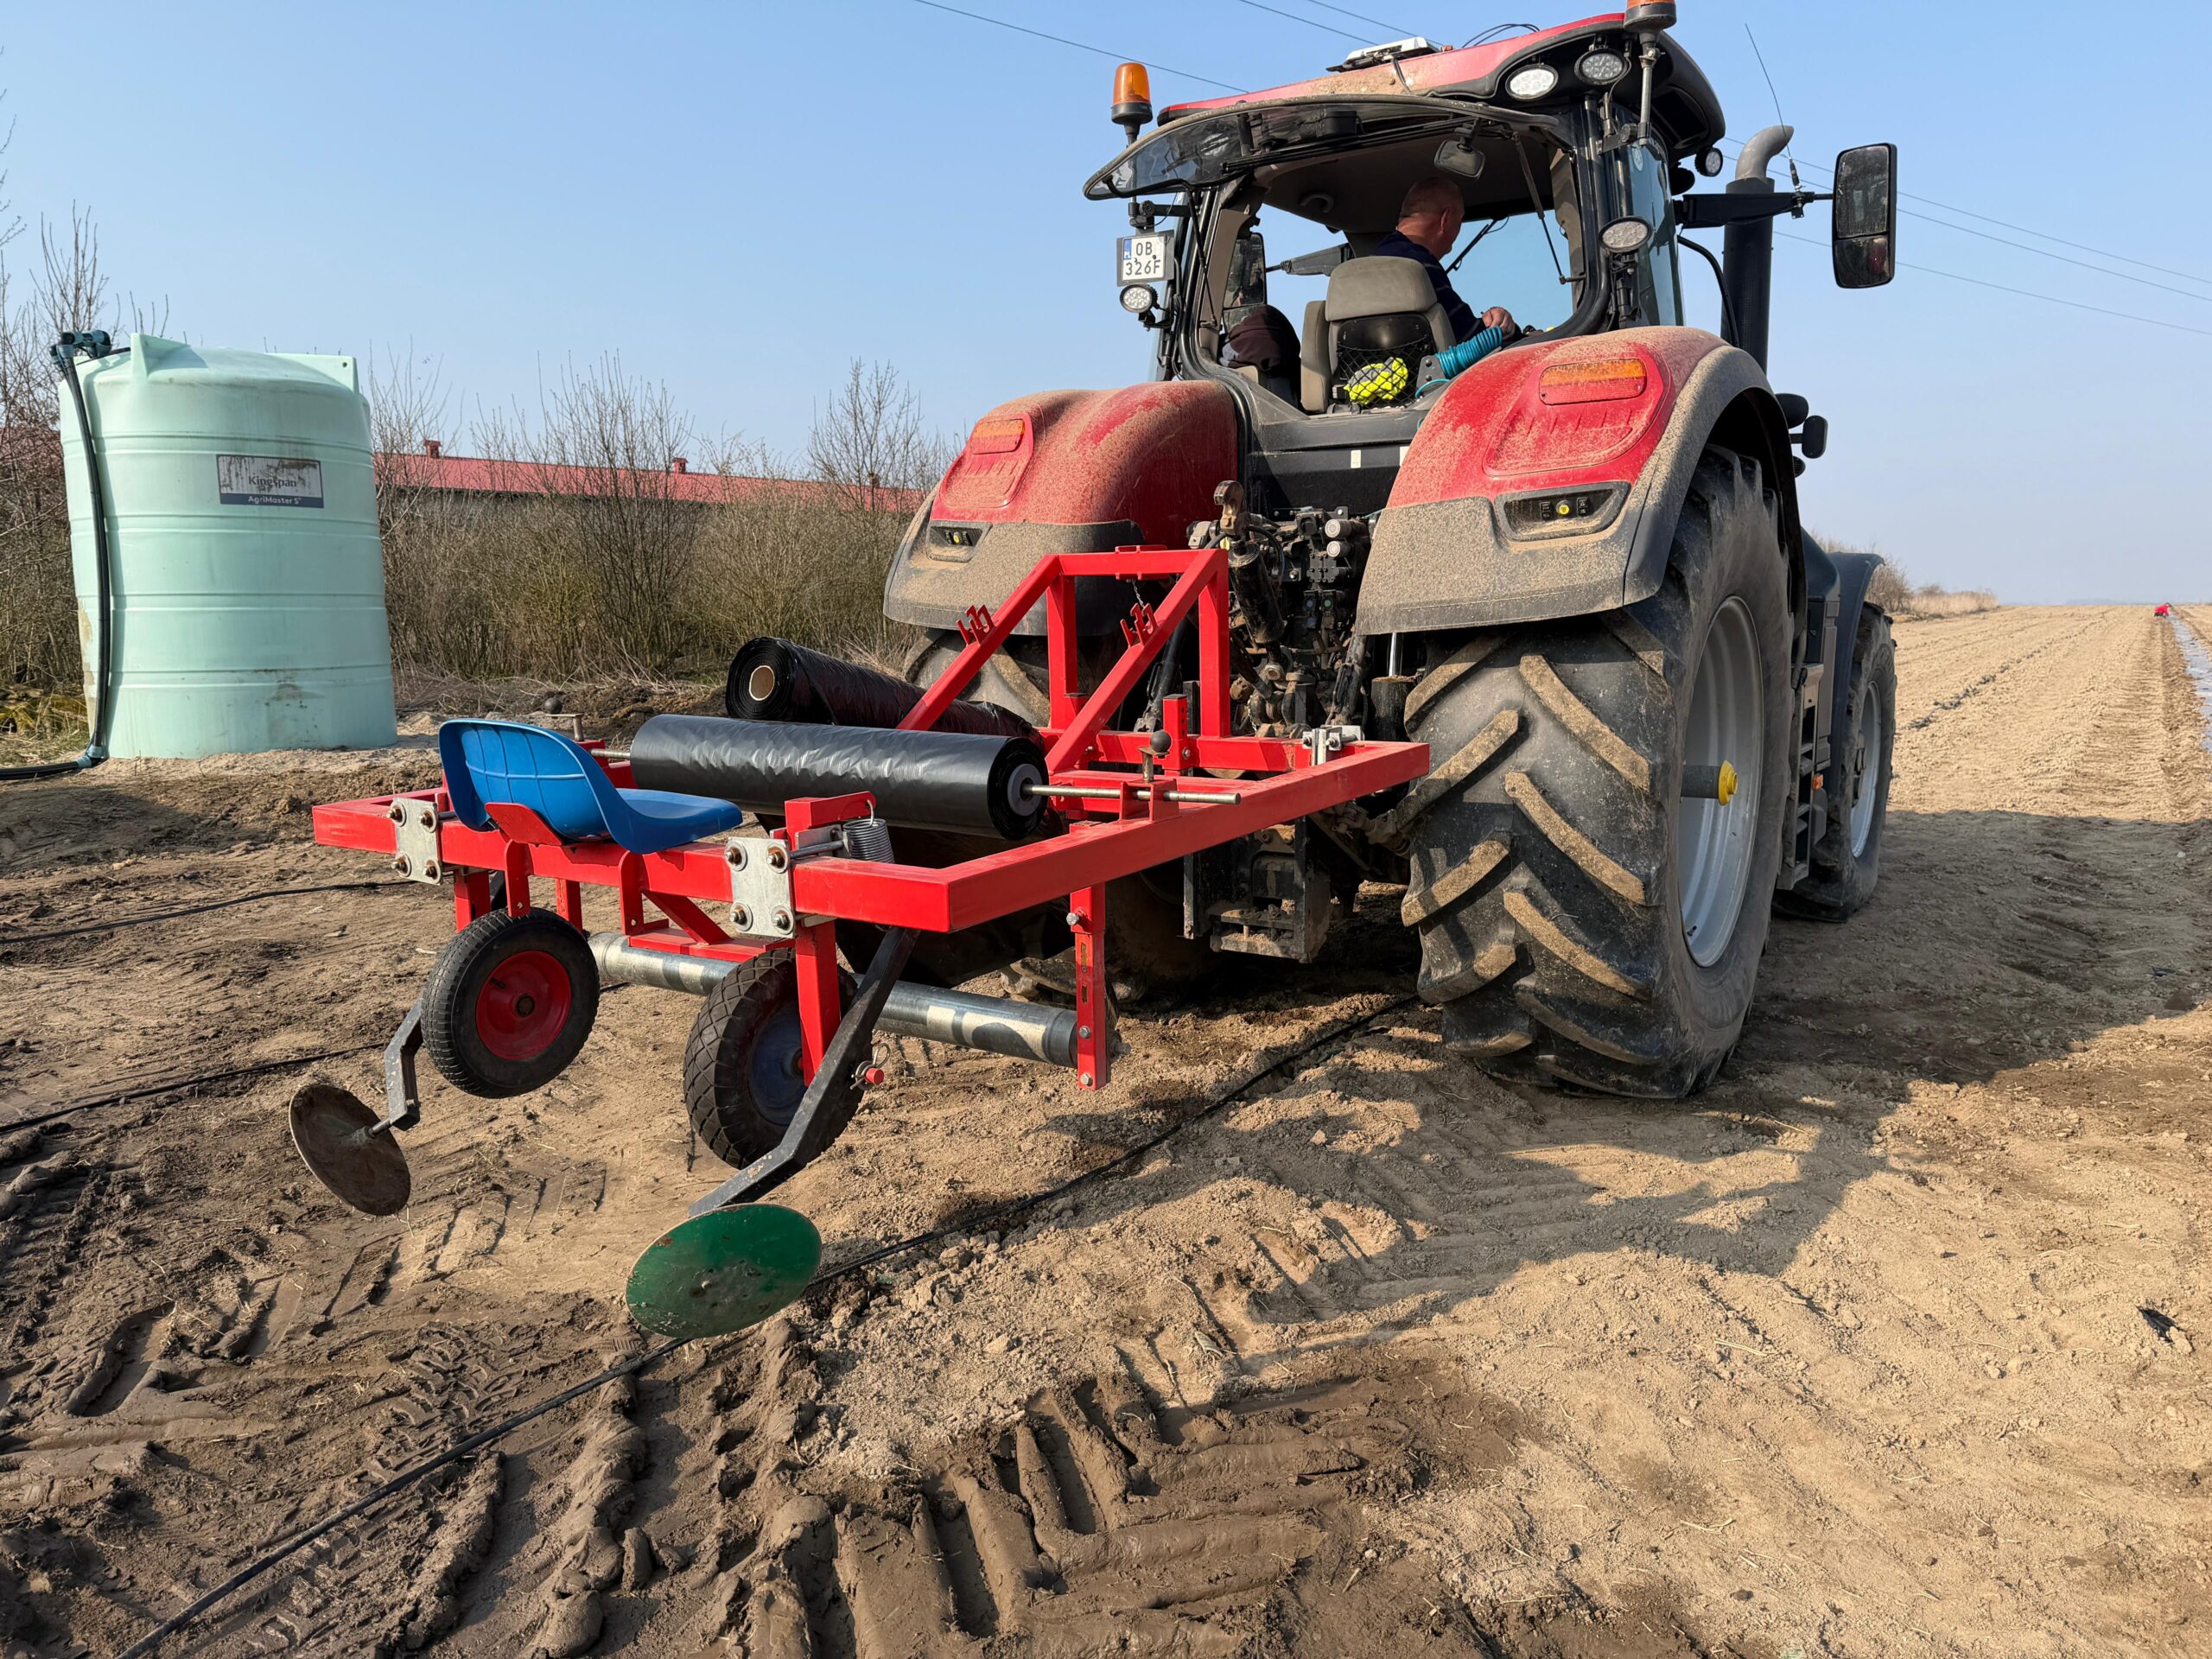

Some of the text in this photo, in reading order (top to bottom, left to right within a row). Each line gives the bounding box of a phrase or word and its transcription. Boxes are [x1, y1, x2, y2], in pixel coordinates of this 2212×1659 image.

[1125, 259, 1161, 276] 326F
[248, 474, 297, 488] Kingspan
[248, 495, 292, 505] AgriMaster
